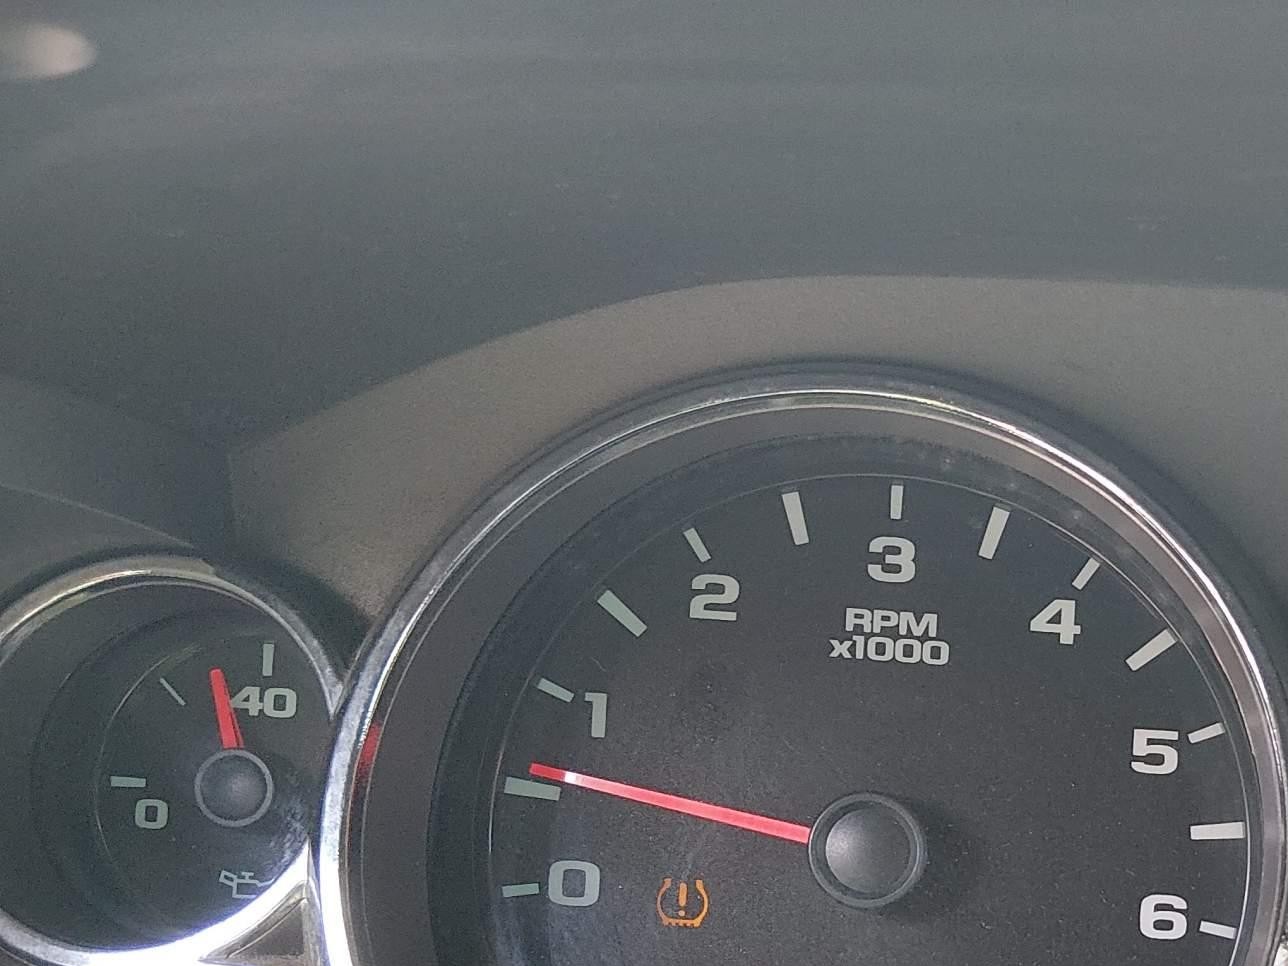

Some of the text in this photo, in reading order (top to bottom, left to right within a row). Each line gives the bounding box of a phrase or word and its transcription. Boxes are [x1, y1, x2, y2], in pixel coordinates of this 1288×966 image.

[867, 537, 917, 584] 3
[689, 573, 741, 622] 2
[844, 607, 939, 638] RPM
[1029, 599, 1082, 645] 4
[828, 635, 950, 666] x1000
[231, 686, 297, 718] 40
[584, 691, 608, 738] 1
[1130, 728, 1180, 776] 5
[134, 798, 169, 830] 0
[548, 860, 601, 908] 0
[1138, 893, 1188, 940] 6
